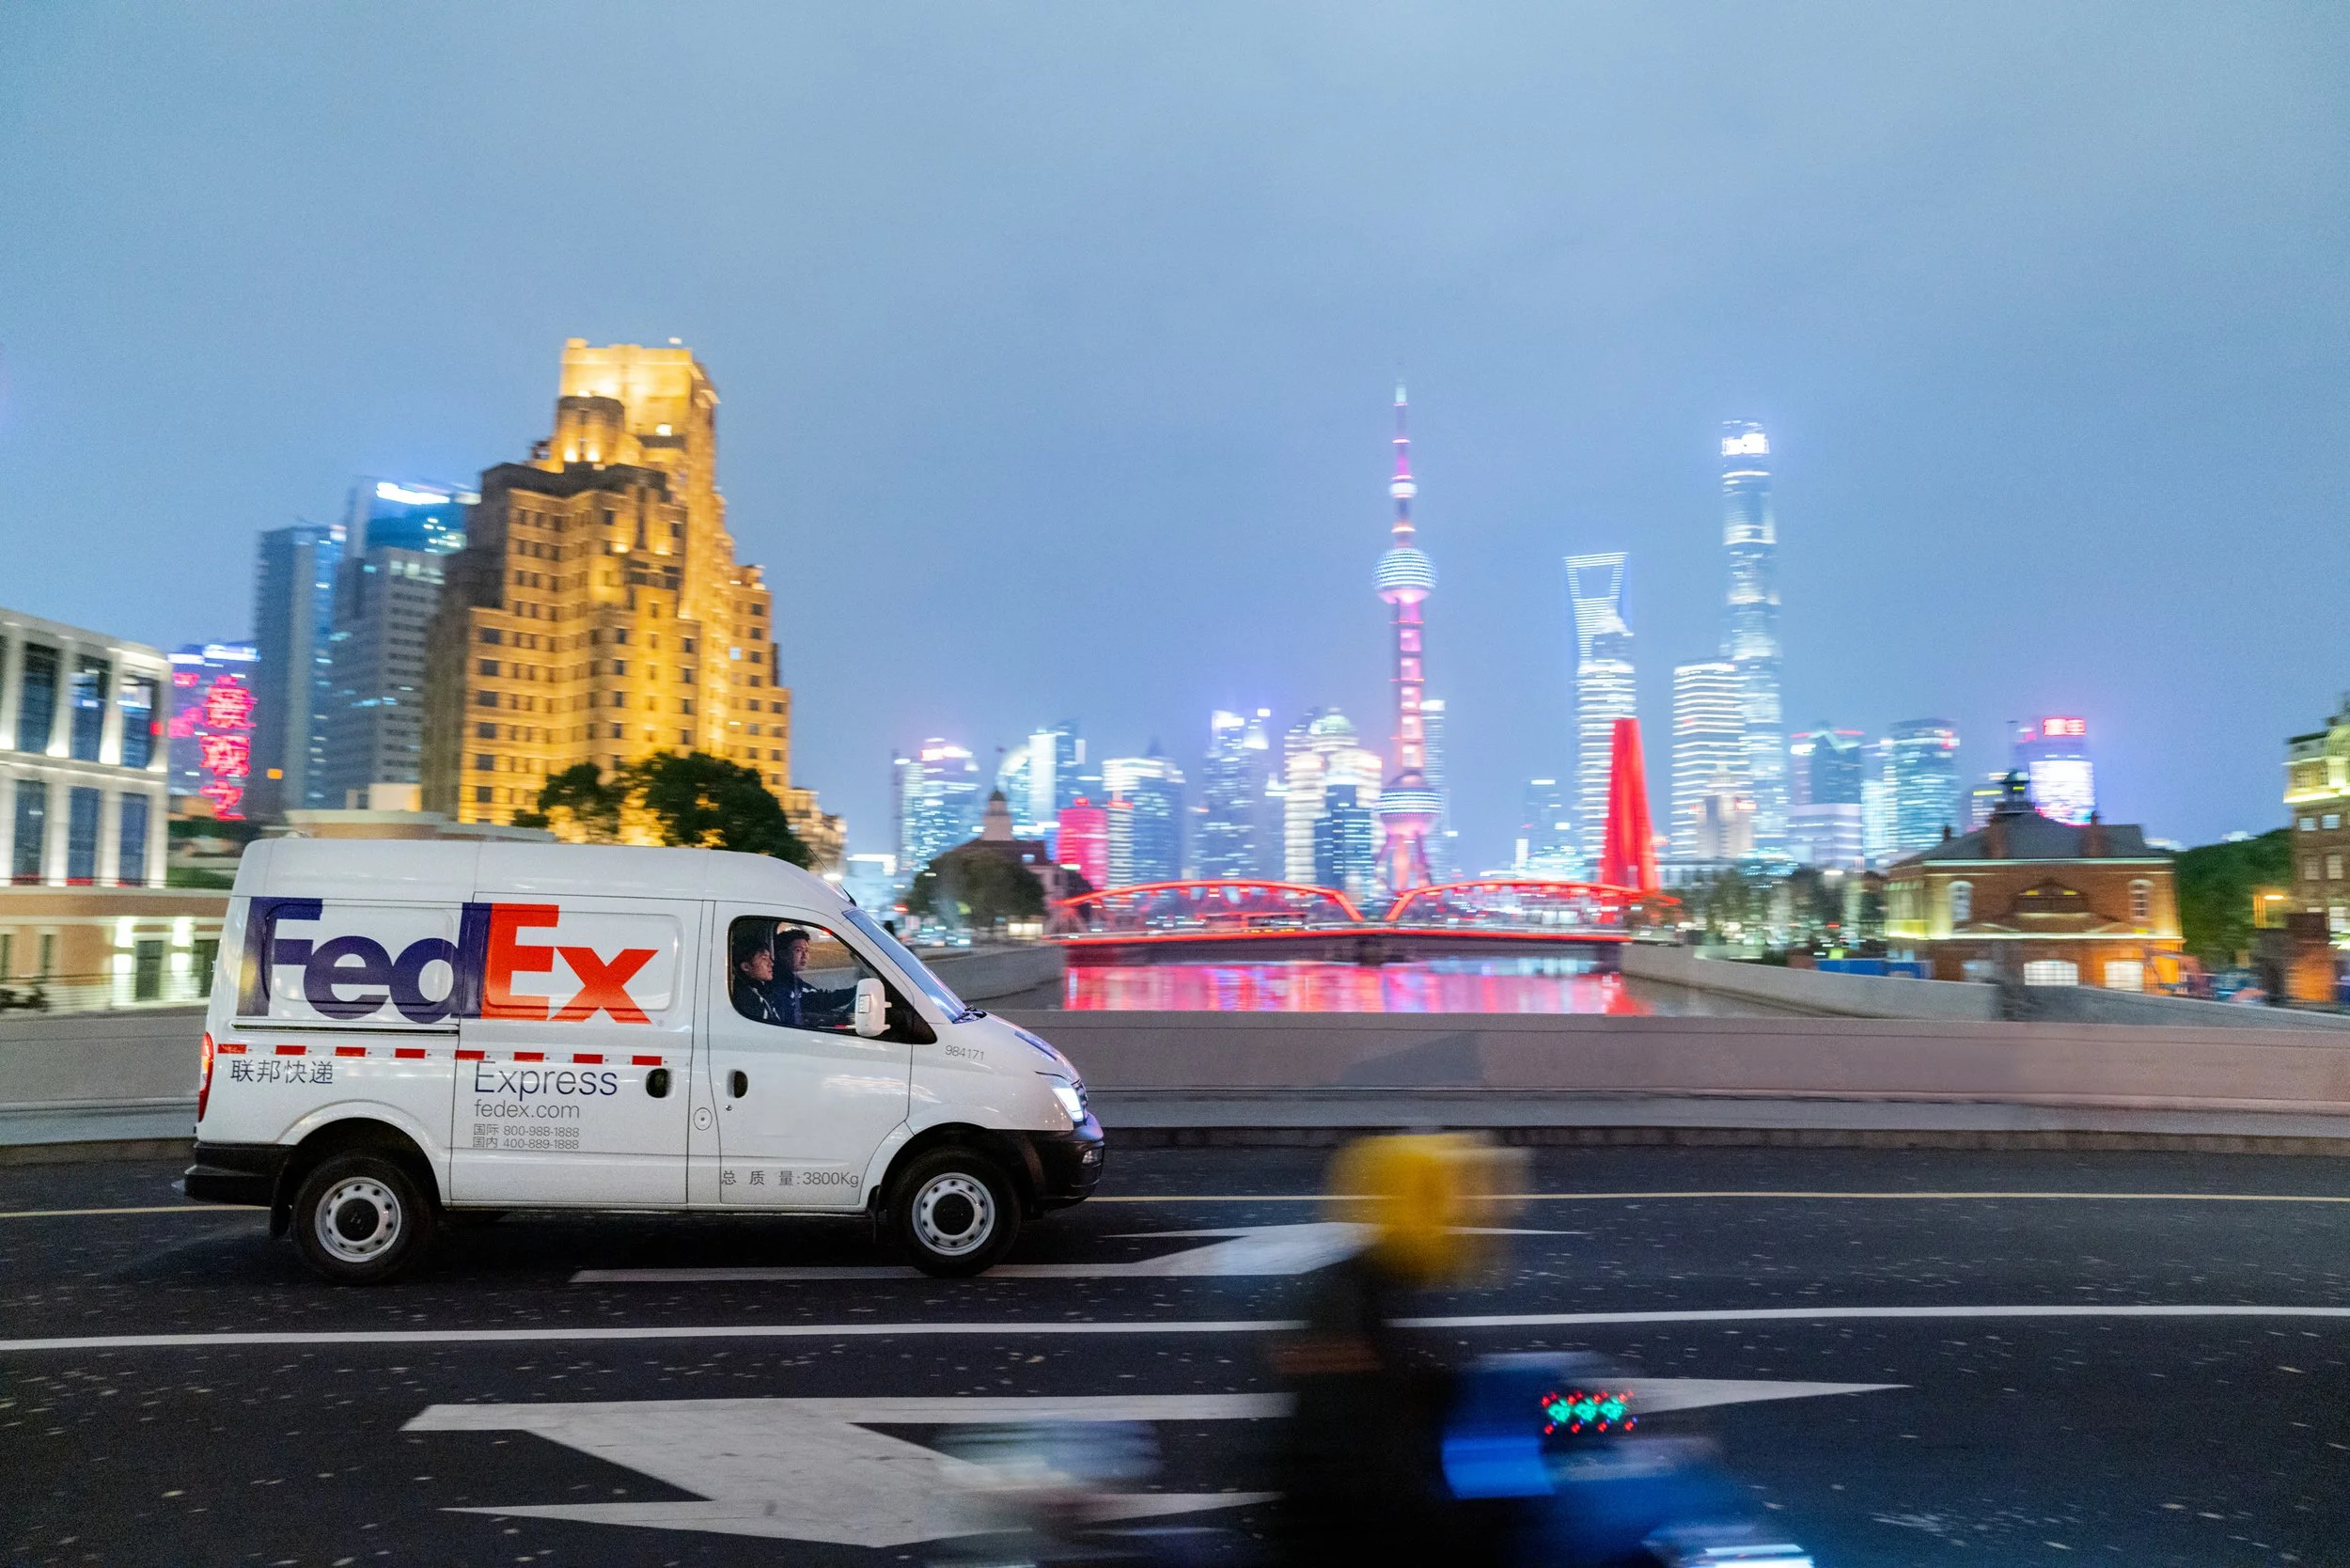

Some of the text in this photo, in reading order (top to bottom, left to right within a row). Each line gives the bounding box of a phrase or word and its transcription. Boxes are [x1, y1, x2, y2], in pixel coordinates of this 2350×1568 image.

[236, 896, 660, 1025] FedEx
[945, 1044, 985, 1061] 984171
[230, 1058, 333, 1084] 联邦快递
[475, 1060, 619, 1102] Express
[474, 1098, 580, 1119] fedex.com
[473, 1123, 580, 1137] 国际 800-988-1888
[472, 1136, 498, 1149] 国内
